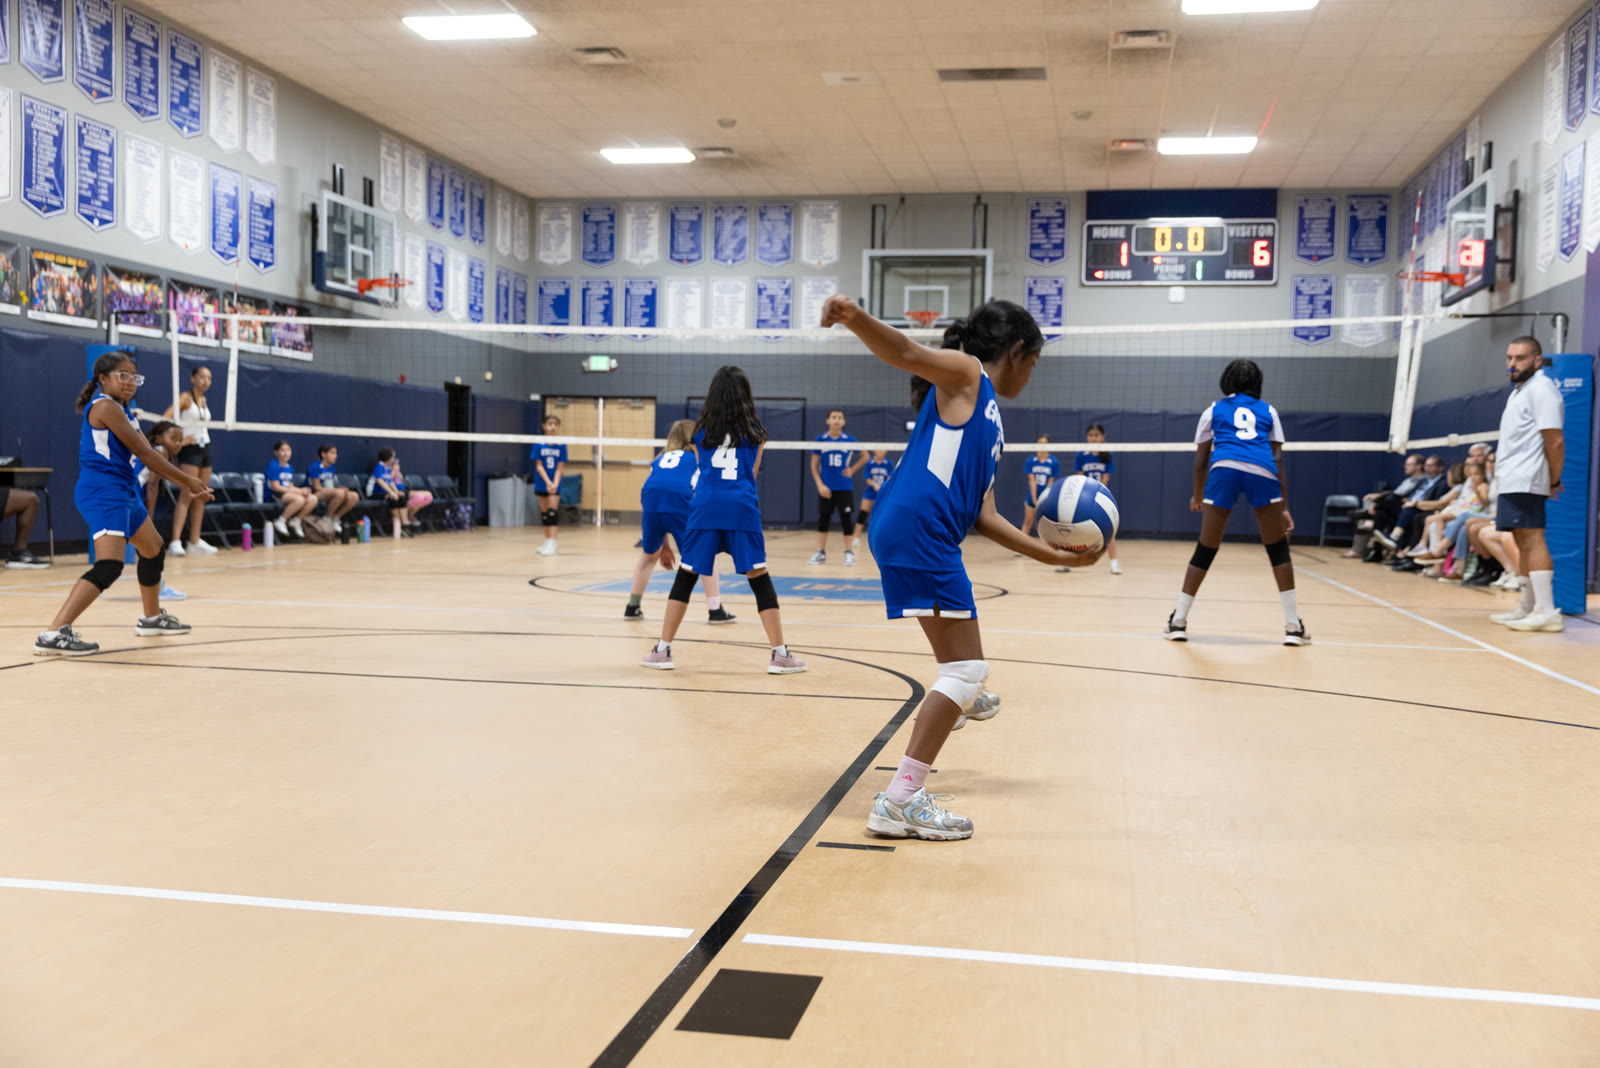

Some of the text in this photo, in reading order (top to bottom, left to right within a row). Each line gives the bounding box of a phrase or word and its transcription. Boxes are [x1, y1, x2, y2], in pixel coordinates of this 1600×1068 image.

[1093, 226, 1127, 238] HOME
[1228, 225, 1274, 237] VISITOR
[1120, 241, 1128, 267] 1
[1253, 240, 1270, 266] 6
[1195, 260, 1203, 280] 1
[1225, 269, 1254, 279] BONUS
[1233, 407, 1258, 440] 9
[659, 450, 684, 469] 8
[711, 433, 738, 480] 4
[829, 454, 842, 467] 16
[917, 809, 933, 822] N
